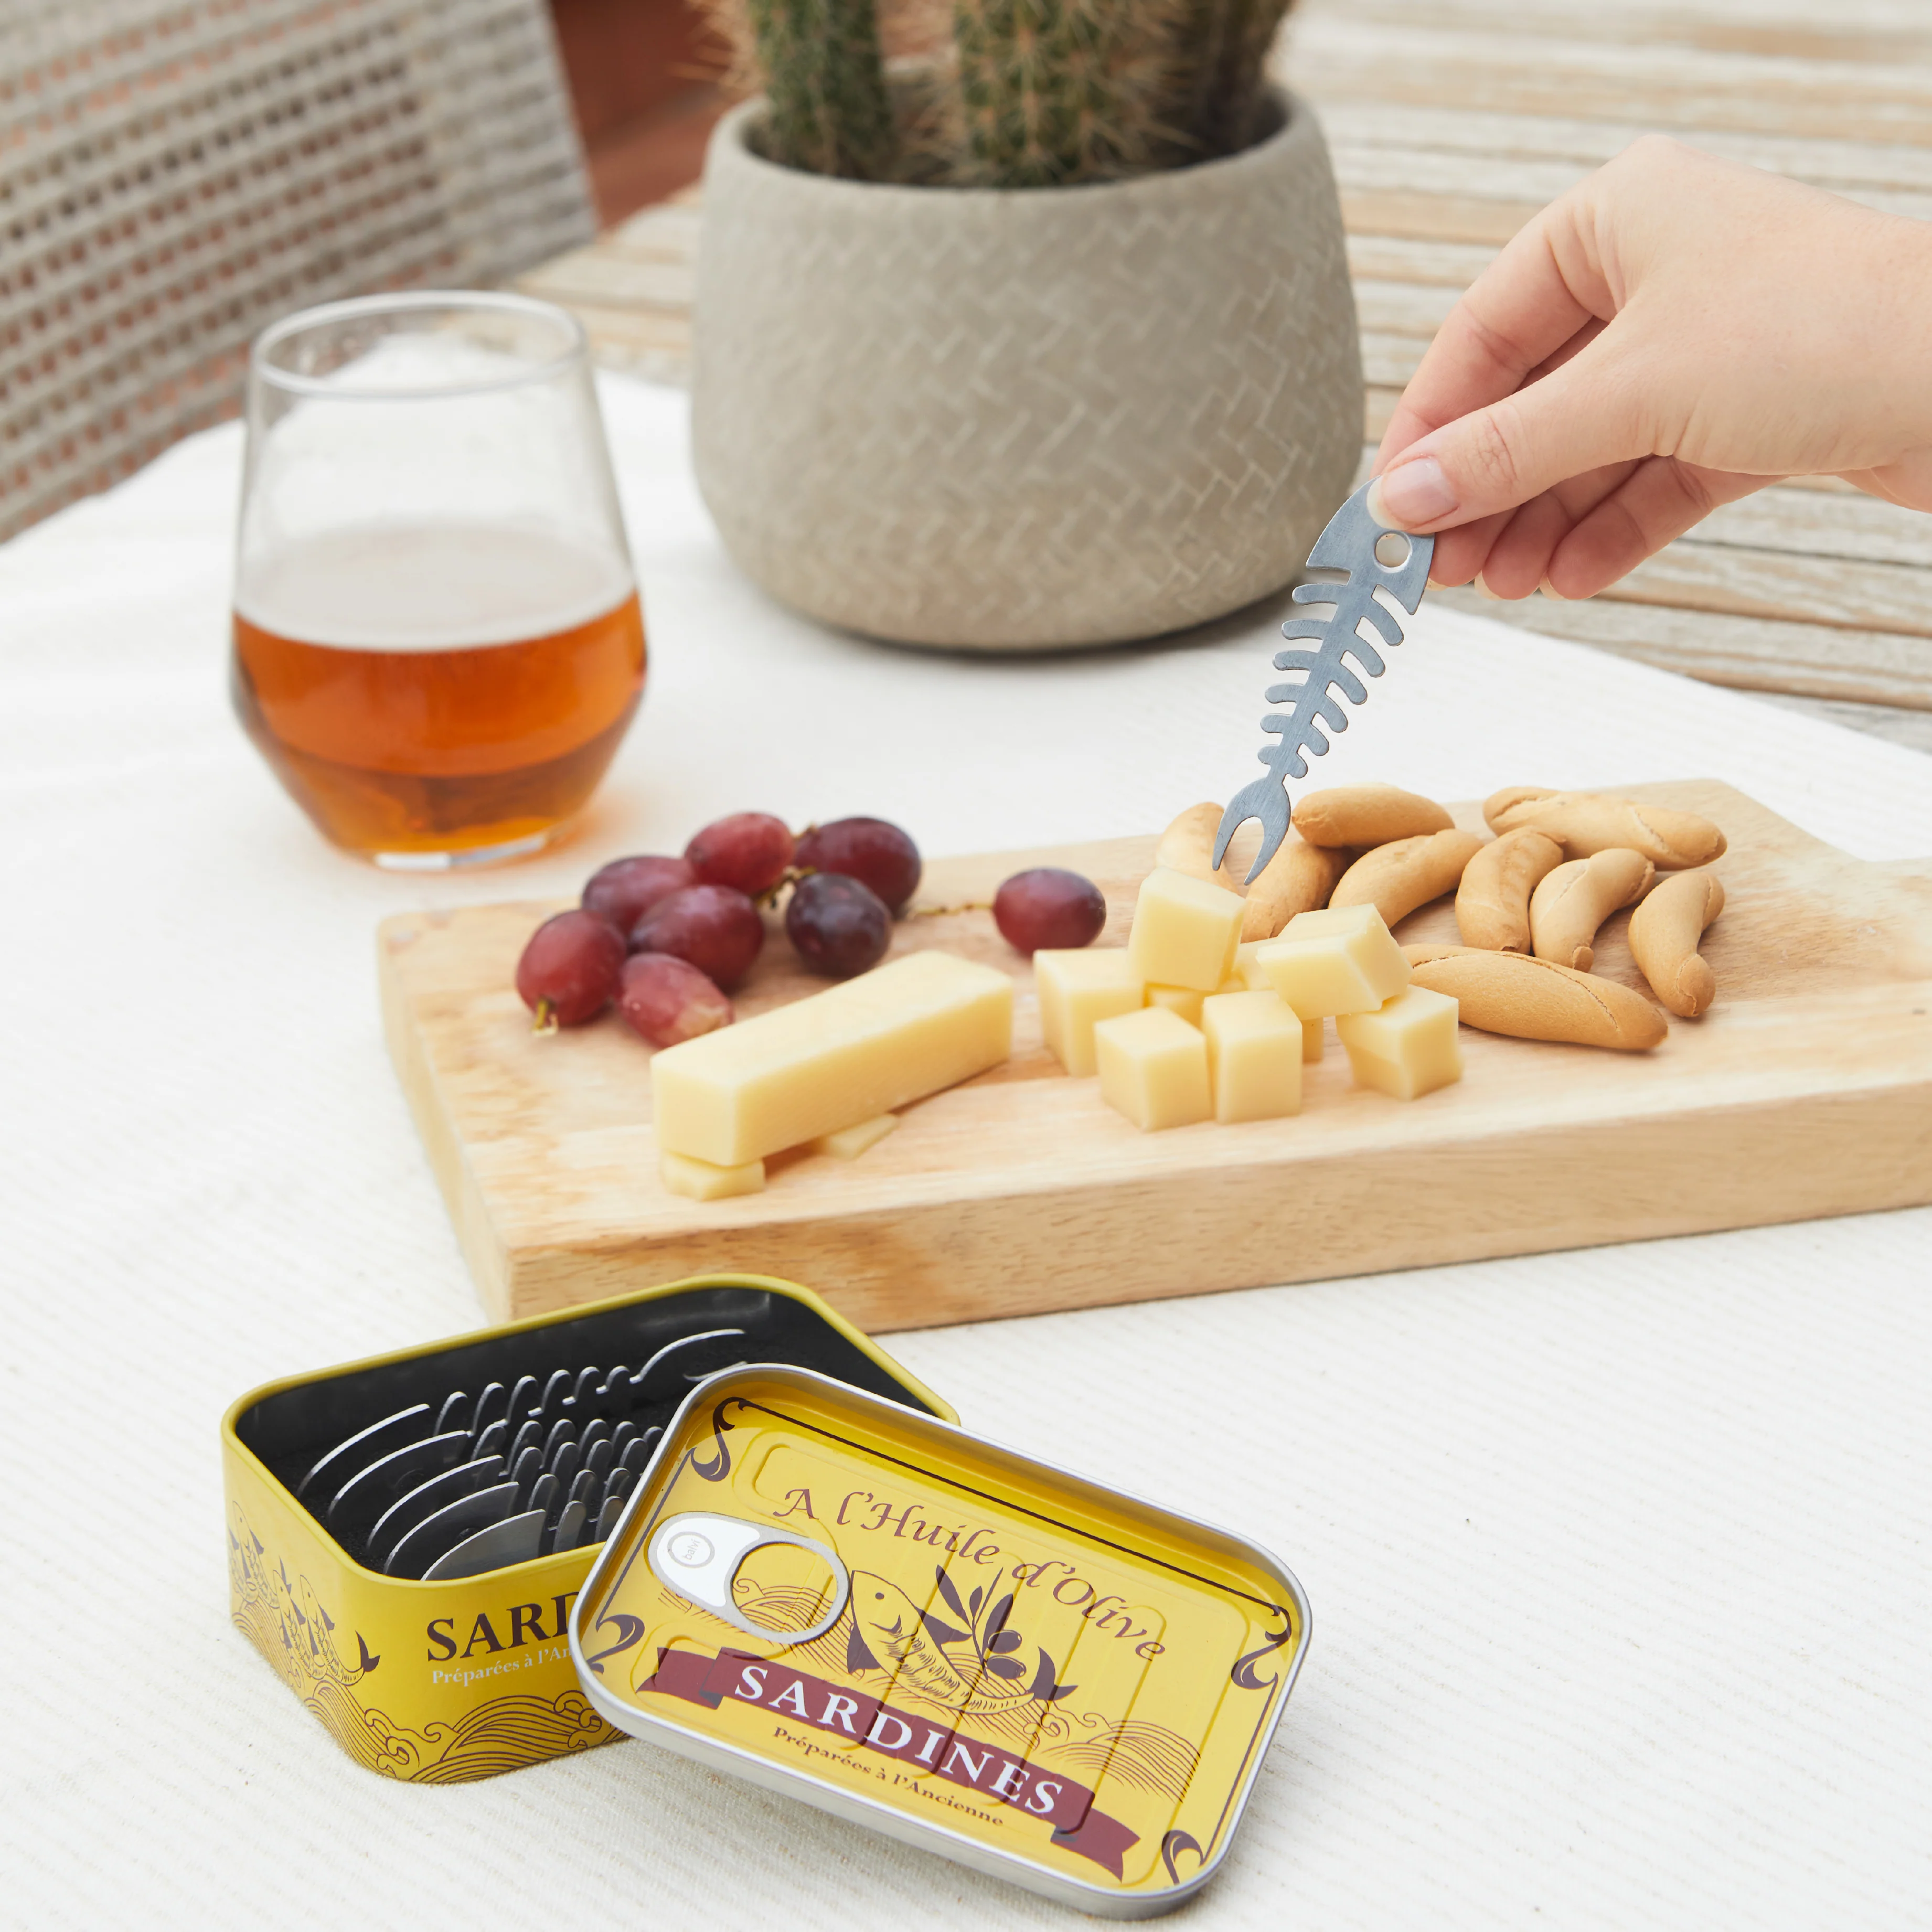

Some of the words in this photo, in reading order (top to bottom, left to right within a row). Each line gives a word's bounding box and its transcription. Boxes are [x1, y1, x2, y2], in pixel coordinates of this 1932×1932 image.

[682, 1538, 701, 1561] balvi
[773, 1489, 819, 1520] A
[837, 1491, 1000, 1565] l'Huile
[1011, 1561, 1165, 1661] d'Olive
[433, 1660, 519, 1687] Préparées
[524, 1653, 533, 1668] à
[735, 1665, 1063, 1813] SARDINES
[773, 1726, 871, 1775] Préparées
[875, 1767, 887, 1781] à
[893, 1773, 1004, 1826] l'Ancienne
